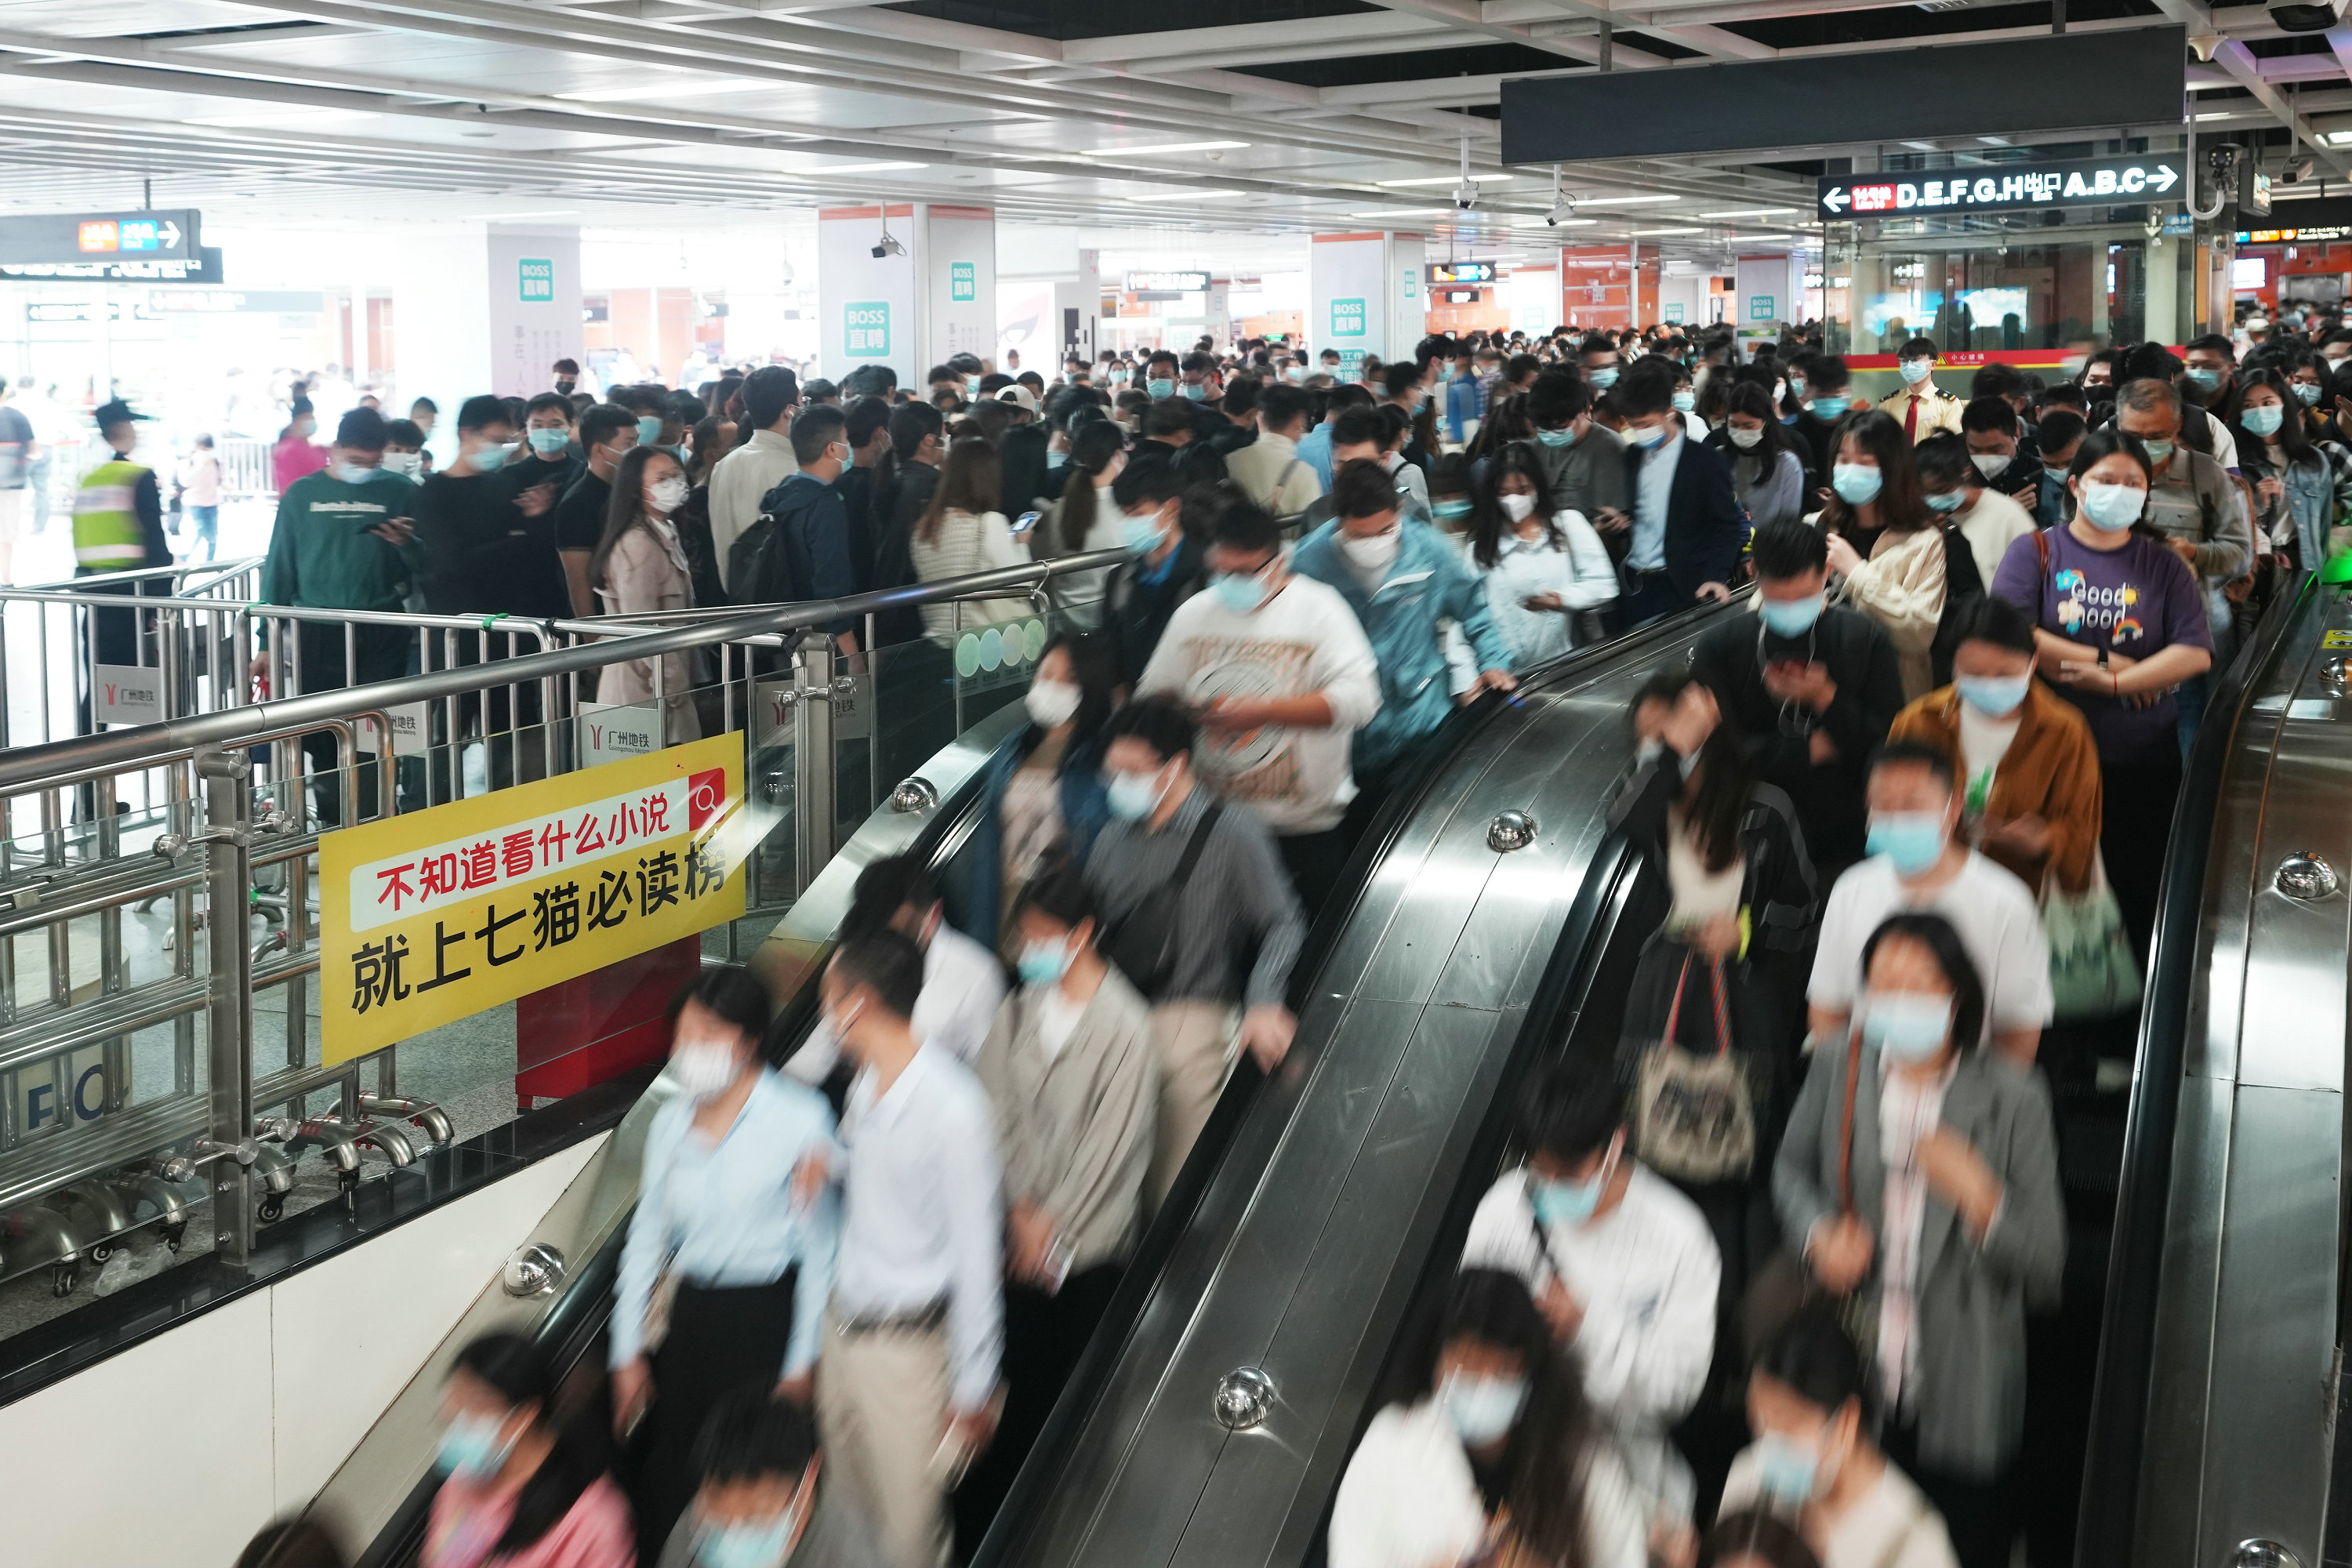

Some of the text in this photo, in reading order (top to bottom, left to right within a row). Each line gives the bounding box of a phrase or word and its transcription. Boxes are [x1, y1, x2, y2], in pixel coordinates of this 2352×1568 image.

[1896, 167, 2146, 209] D.E.F.G.H 出口 A.B.C
[521, 265, 549, 277] BOSS
[953, 268, 973, 278] BOSS
[954, 281, 973, 296] 直聘
[1334, 303, 1363, 314] BOSS
[848, 310, 886, 325] BOSS
[1334, 316, 1363, 332] 直聘
[849, 328, 886, 349] 直聘
[2071, 577, 2126, 607] Good
[608, 731, 649, 747] 广州地铁
[377, 792, 670, 912] 不知道看什么小说
[350, 833, 726, 1015] 就上七猫必读榜
